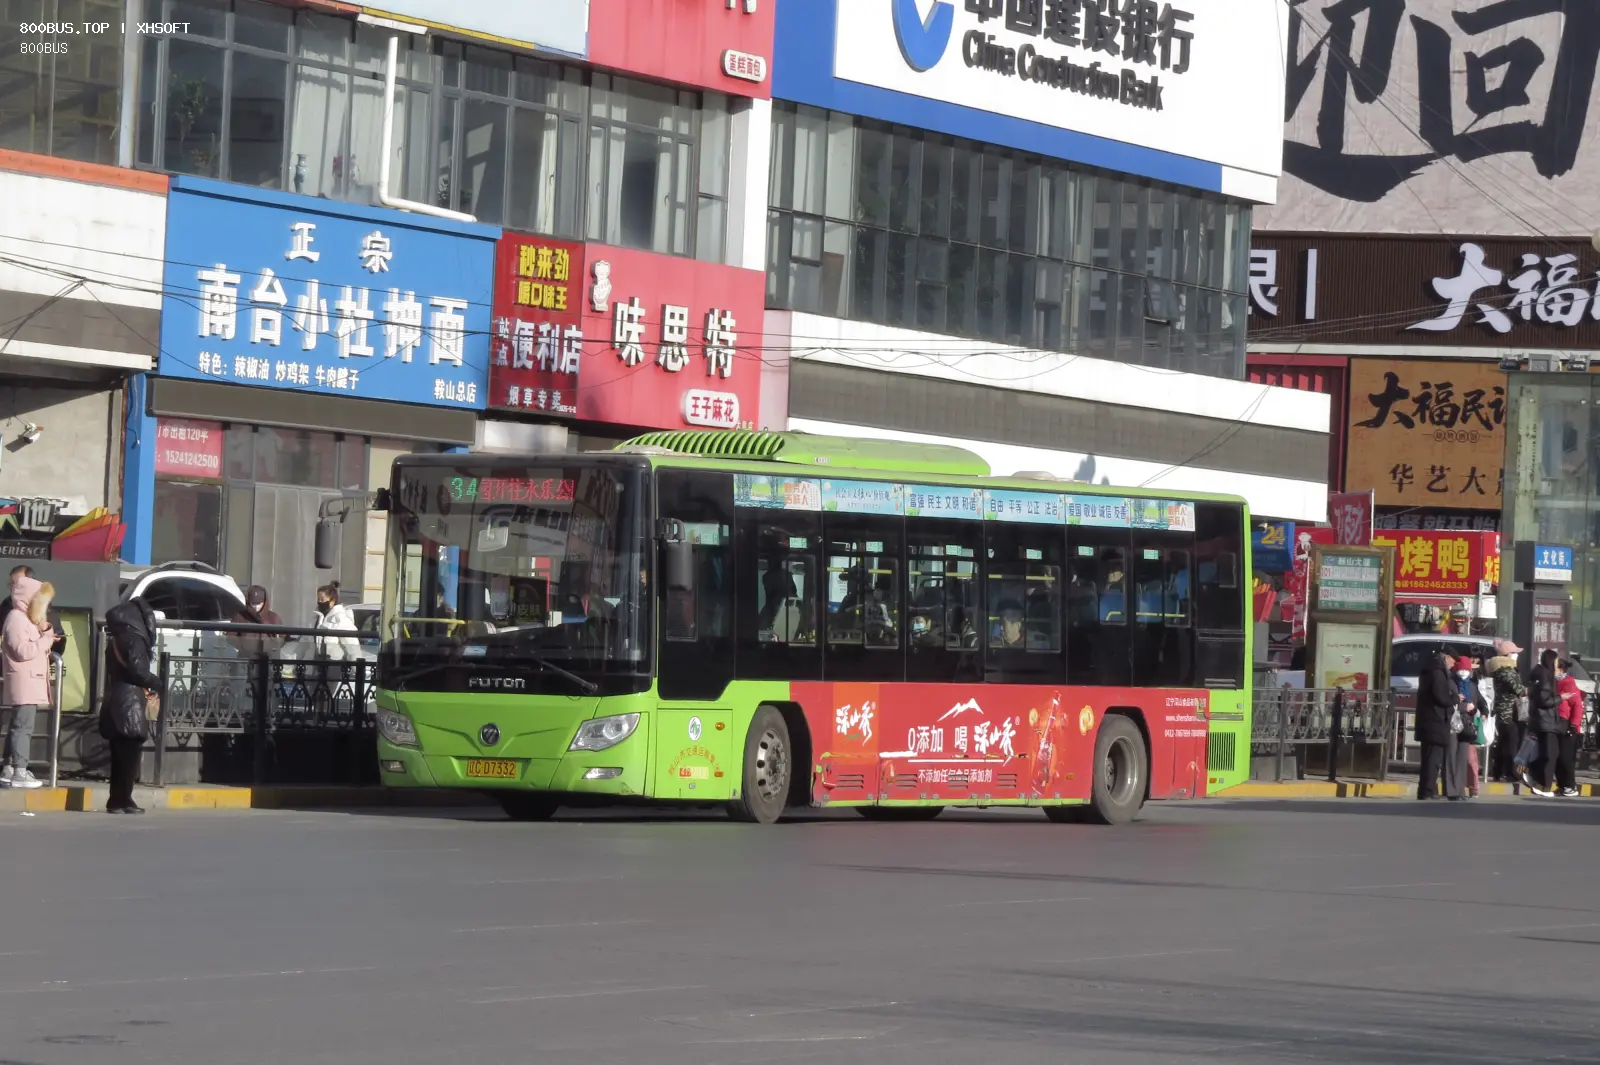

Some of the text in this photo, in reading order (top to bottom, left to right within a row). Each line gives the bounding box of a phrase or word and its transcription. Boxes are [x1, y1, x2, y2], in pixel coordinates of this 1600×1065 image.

[962, 29, 1164, 112] China Construction Bank
[284, 221, 393, 274] 正宗
[519, 244, 570, 282] 秒来劲
[1405, 241, 1600, 333] 大福
[511, 317, 583, 376] 便利店
[612, 296, 738, 380] 味思特
[234, 355, 271, 382] 辣椒油
[275, 360, 310, 386] 炒鸡架
[433, 377, 478, 404] 鞍山总店
[508, 384, 562, 412] 烟草专卖
[690, 396, 735, 423] 王子麻花
[451, 477, 478, 501] 34
[1389, 463, 1506, 497] 华艺大
[909, 493, 977, 512] 富强 民主 文明 和谐
[990, 498, 1059, 516] 自由 平等 公正 法治
[1068, 502, 1127, 520] 爱国 敬业 诚信 友善
[1373, 535, 1471, 580] 烤鸭
[468, 677, 526, 689] FOTON
[908, 725, 944, 753] 0添加
[954, 725, 968, 754] 喝
